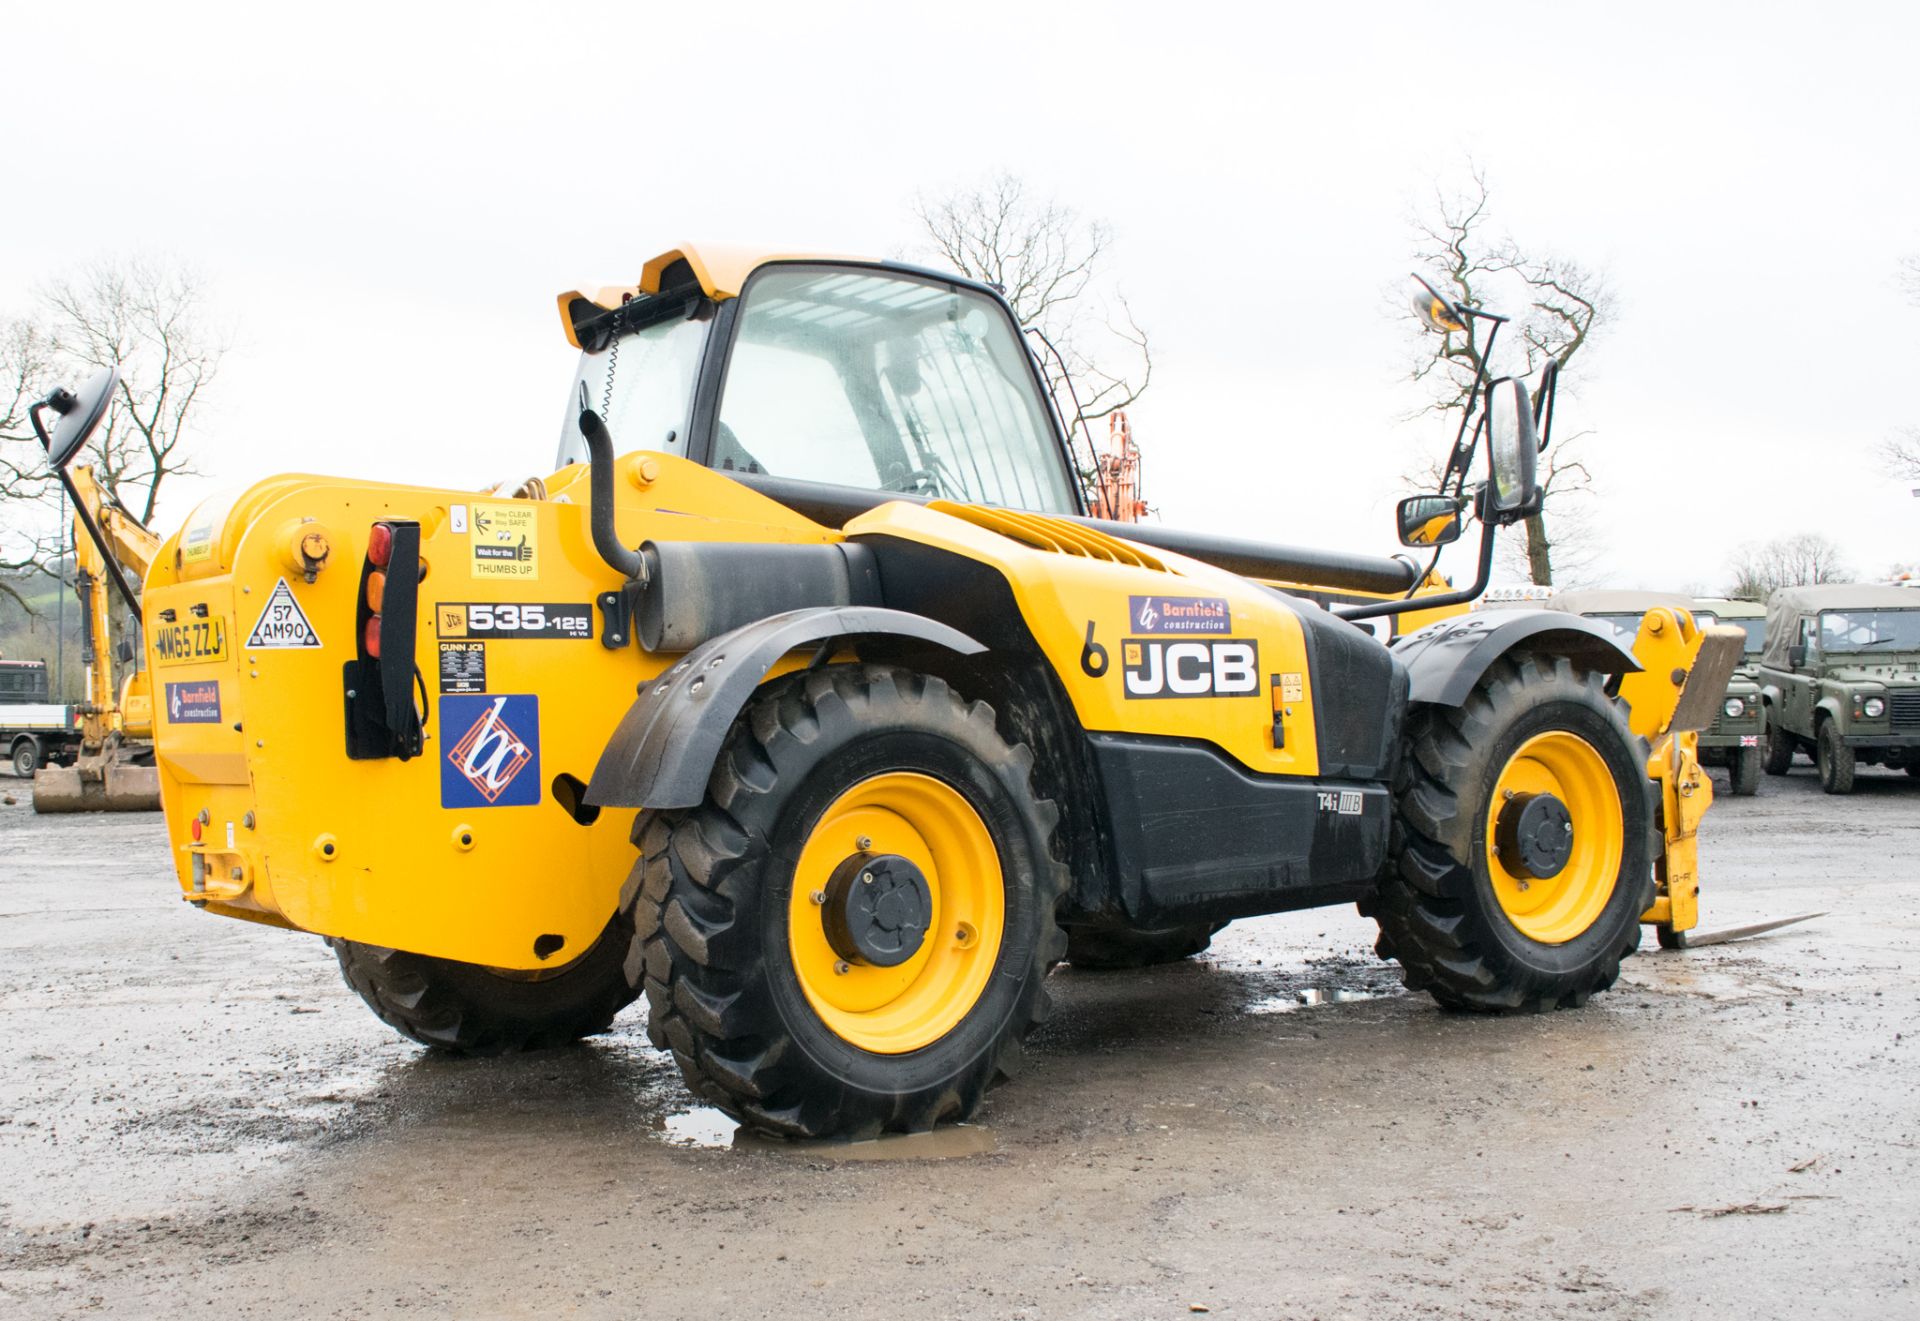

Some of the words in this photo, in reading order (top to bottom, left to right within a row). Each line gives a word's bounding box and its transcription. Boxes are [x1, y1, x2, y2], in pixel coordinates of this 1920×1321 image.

[477, 548, 491, 556] Wait
[503, 549, 513, 557] the
[477, 564, 517, 574] THUMBS
[519, 566, 532, 574] UP
[274, 605, 292, 621] 57
[469, 605, 588, 630] 535-125
[1163, 603, 1224, 617] Barnfield
[263, 623, 304, 639] AM90
[1164, 620, 1225, 630] construction
[193, 622, 220, 656] ZZJ
[1081, 620, 1109, 678] 6
[1126, 643, 1257, 694] JCB
[181, 687, 216, 703] Barnfield
[183, 708, 217, 717] construction
[1317, 793, 1338, 811] T4i
